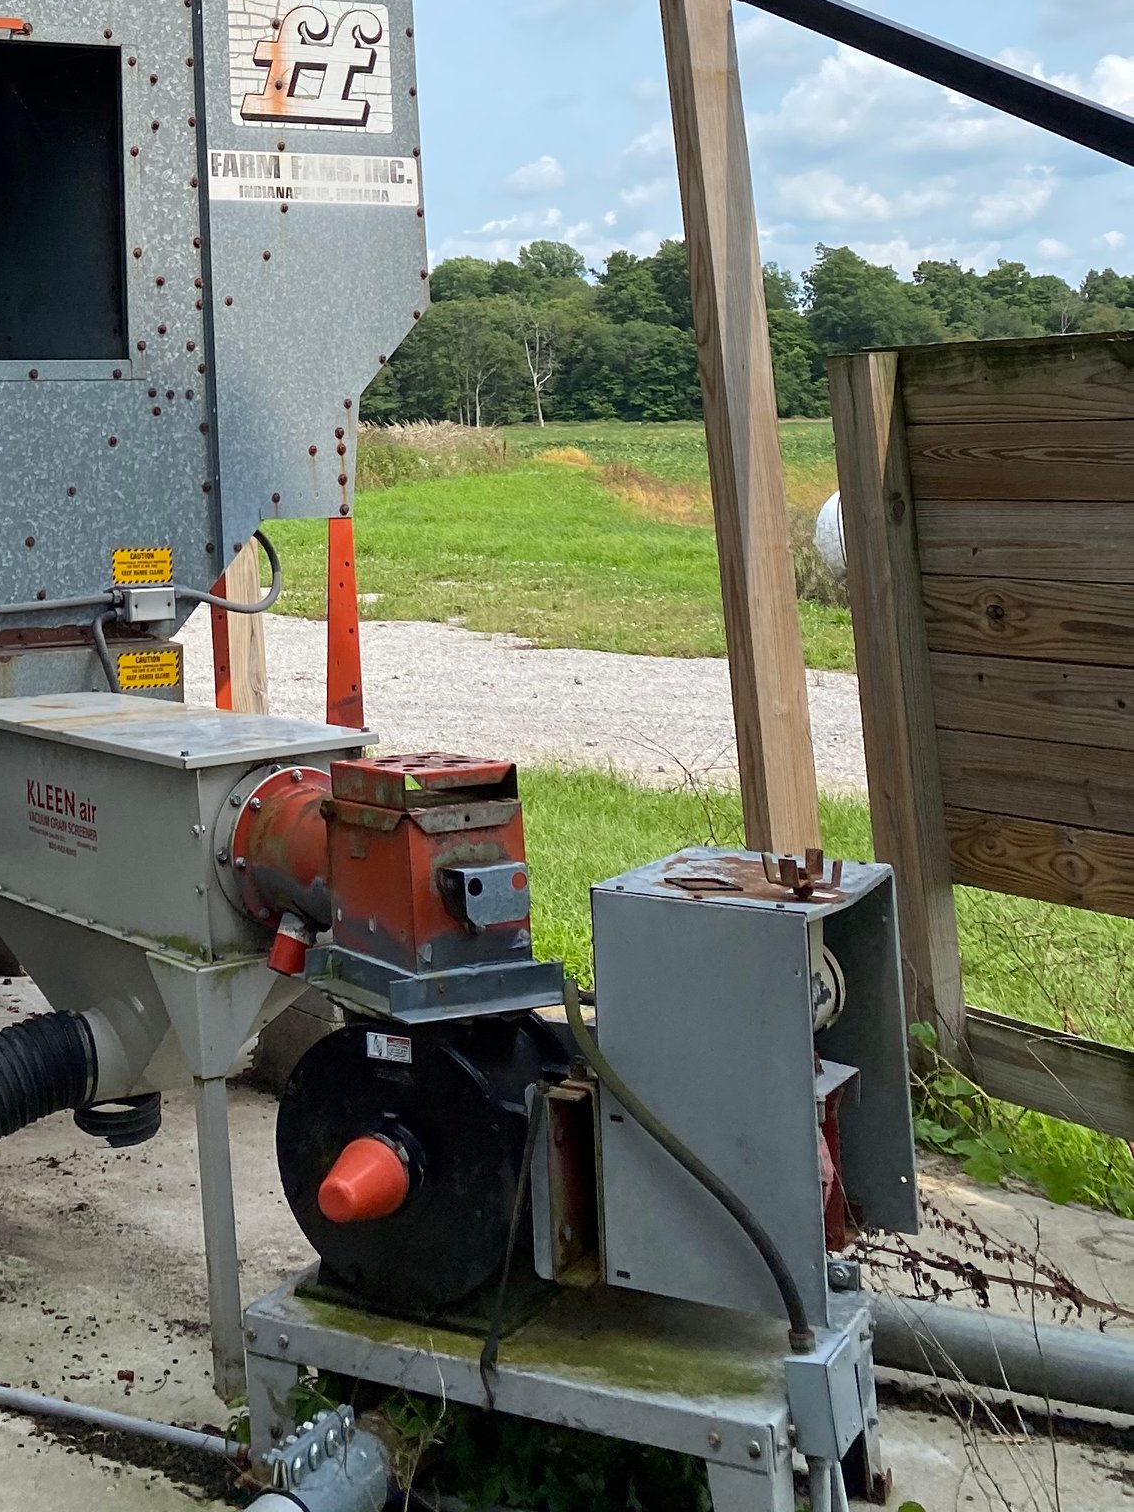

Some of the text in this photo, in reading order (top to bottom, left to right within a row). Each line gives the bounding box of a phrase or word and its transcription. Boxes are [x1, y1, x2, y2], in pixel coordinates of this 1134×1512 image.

[211, 153, 281, 178] FARM
[364, 159, 413, 184] INC.
[130, 552, 155, 560] CAUTION
[135, 656, 160, 664] CAUTION
[27, 779, 97, 824] KLEEN air
